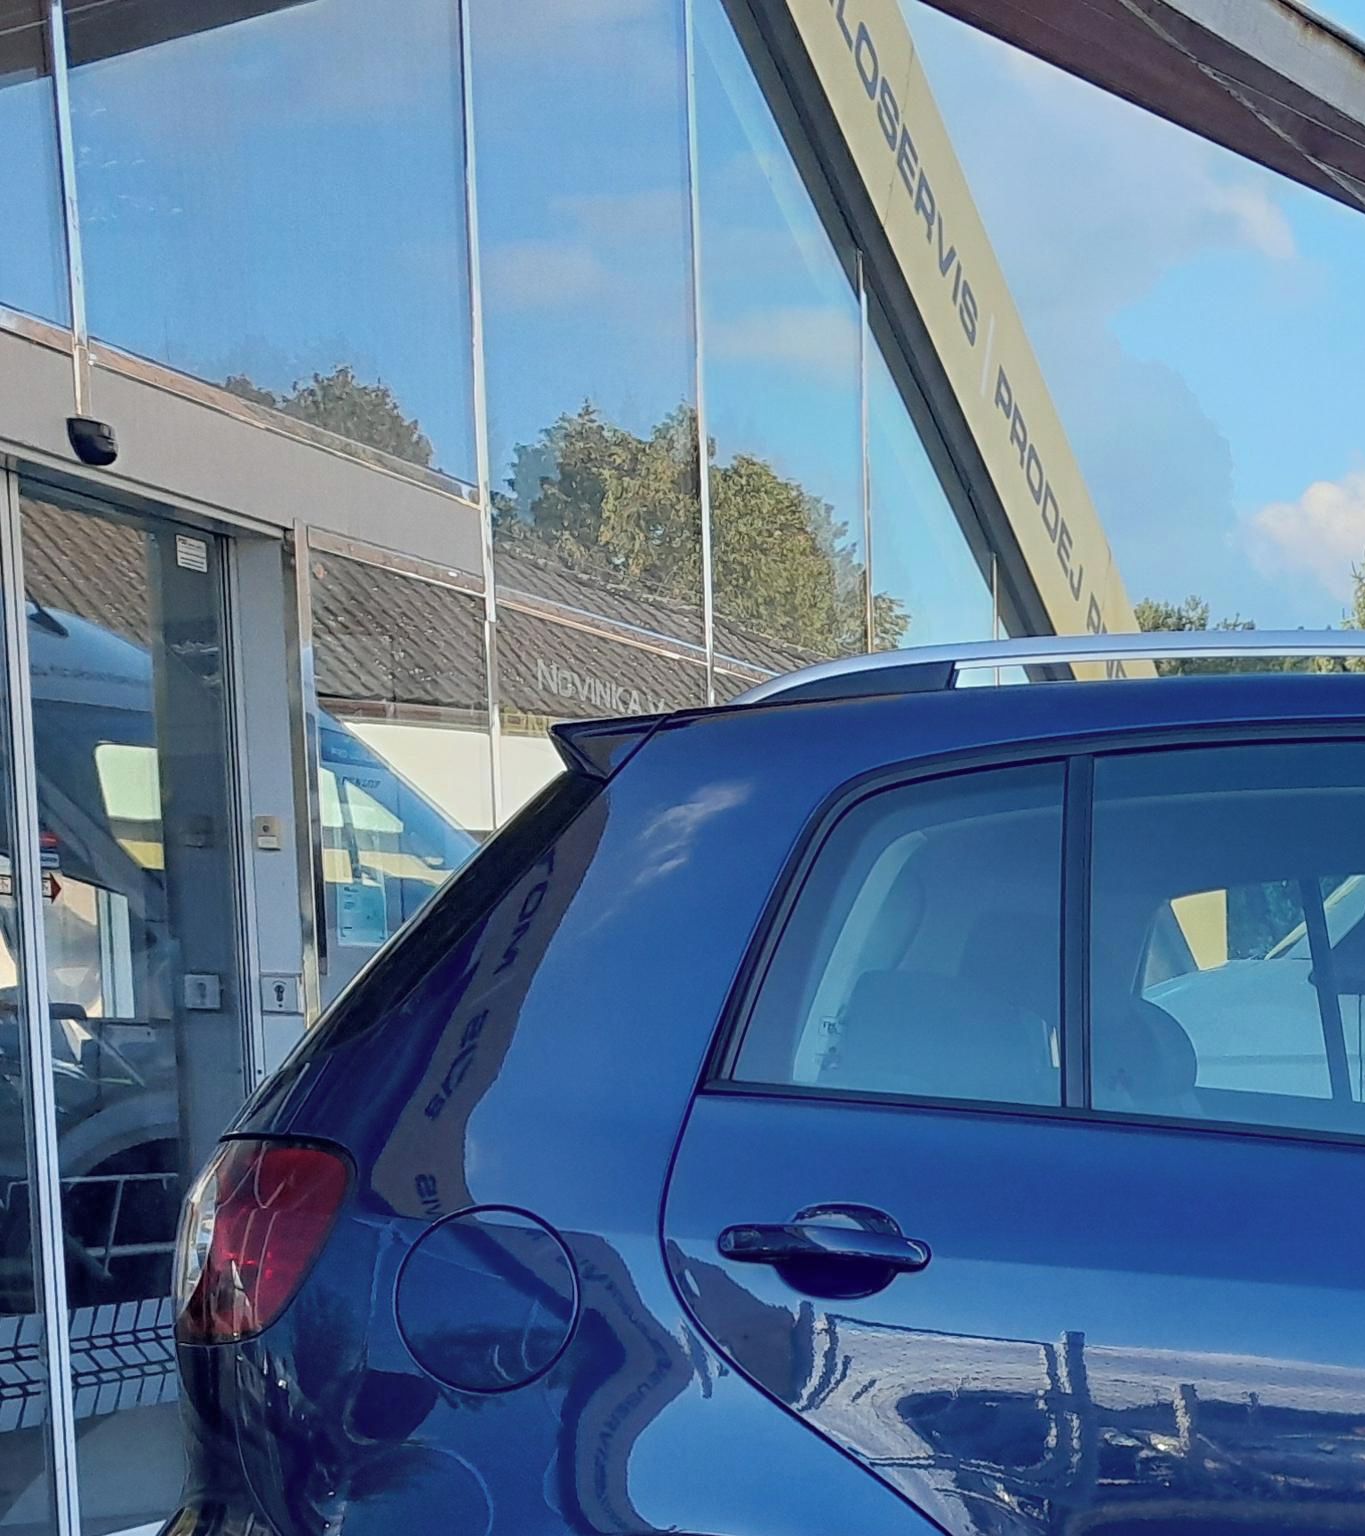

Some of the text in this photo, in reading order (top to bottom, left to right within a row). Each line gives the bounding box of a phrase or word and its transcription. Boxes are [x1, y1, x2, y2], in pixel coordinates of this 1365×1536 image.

[831, 0, 1083, 601] LOSERVIS PRODEJ
[537, 658, 642, 715] NOVINKA
